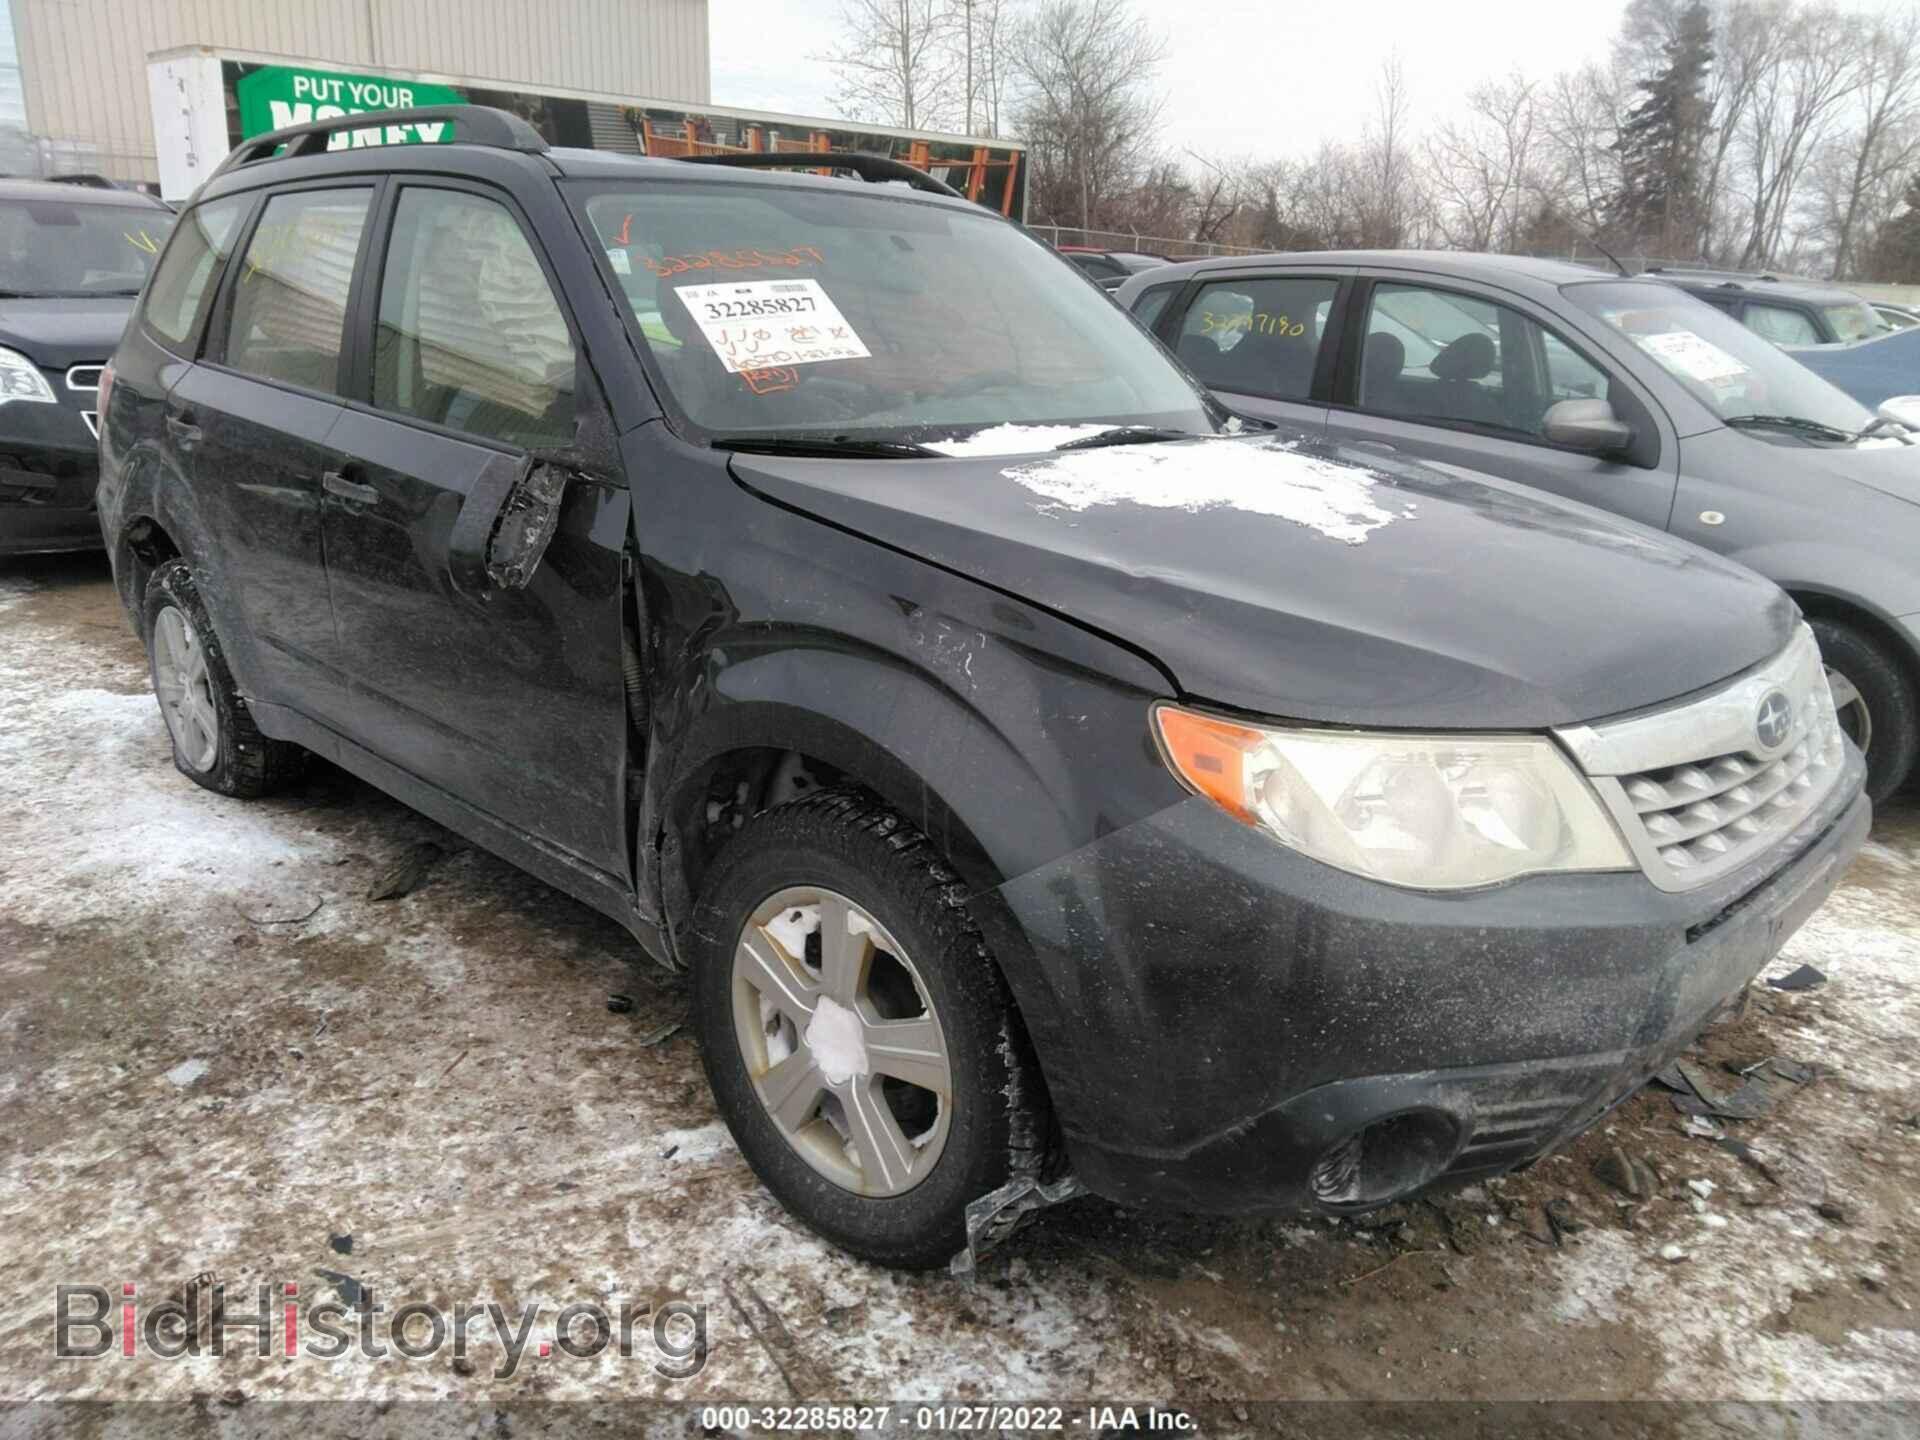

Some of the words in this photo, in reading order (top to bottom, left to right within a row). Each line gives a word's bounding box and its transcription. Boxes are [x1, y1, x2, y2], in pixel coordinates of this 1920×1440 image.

[293, 76, 344, 103] PUT
[347, 82, 414, 109] YOUR
[703, 296, 816, 320] 32285827
